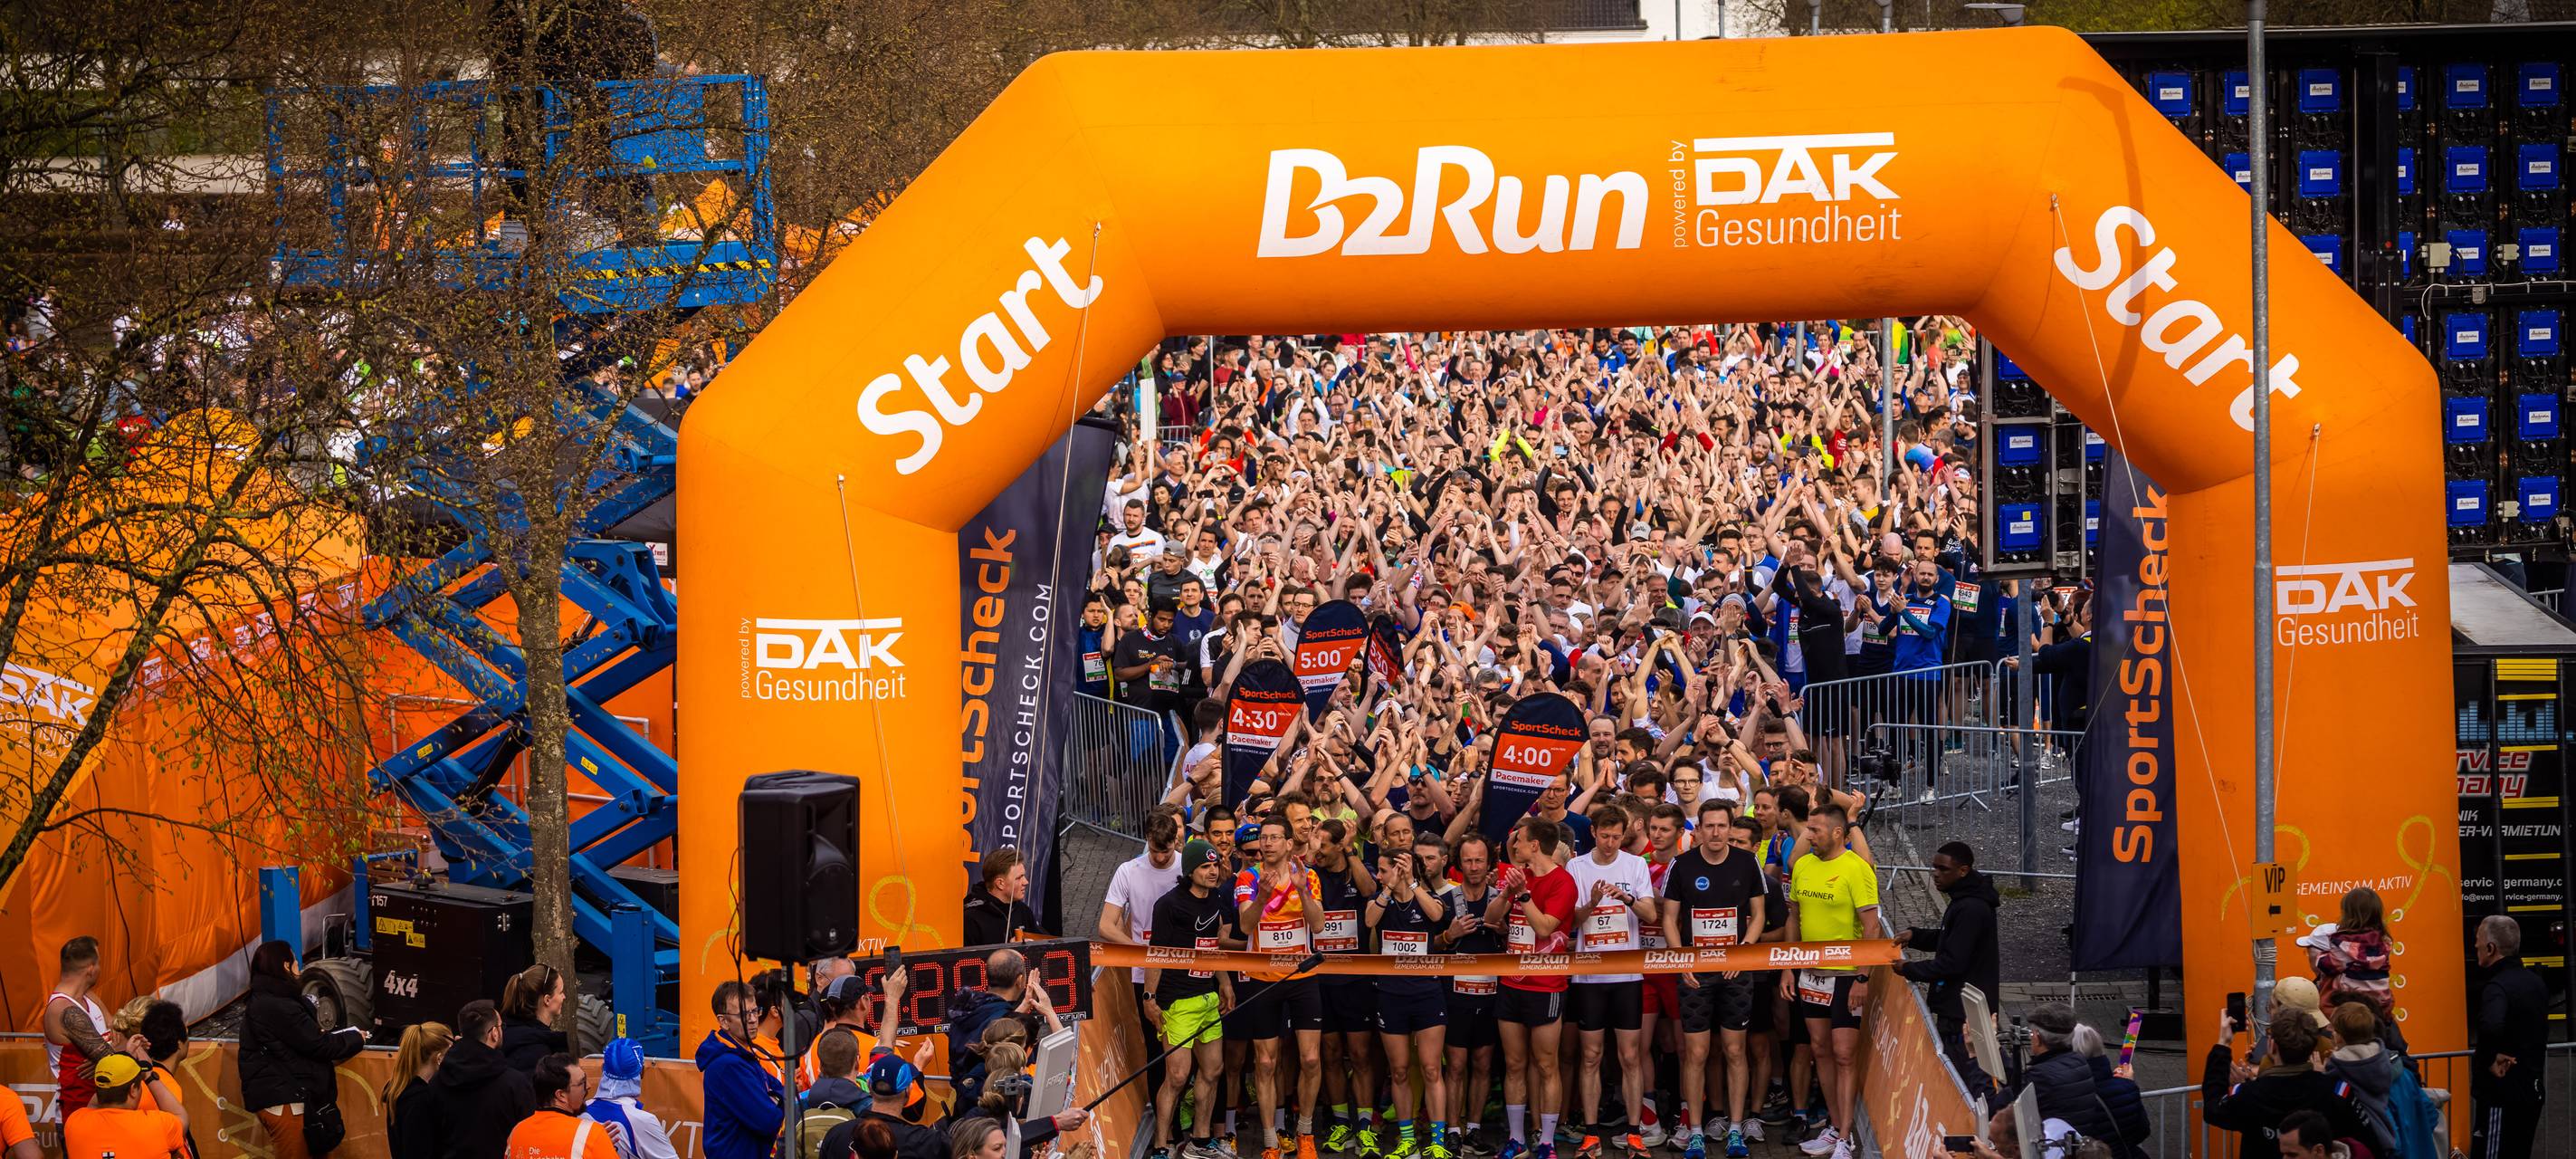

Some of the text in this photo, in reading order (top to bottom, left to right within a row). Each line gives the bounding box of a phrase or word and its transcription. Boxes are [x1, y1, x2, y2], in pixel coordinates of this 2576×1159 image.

[1693, 131, 1901, 206] DAK
[1673, 139, 1688, 248] powered by
[1257, 145, 1649, 259] B2Run
[1695, 204, 1901, 248] Gesundheit
[2054, 206, 2301, 432] Start
[857, 236, 1103, 474] Start
[2276, 558, 2419, 615] DAK
[1305, 627, 1362, 639] SportScheck
[2277, 609, 2419, 647] Gesundheit
[756, 617, 905, 669] DAK
[739, 618, 750, 698] powered by
[1301, 649, 1340, 669] 5:00
[1298, 675, 1337, 685] Pacemaker
[2113, 484, 2168, 862] SportScheck
[756, 669, 906, 702] Gesundheit
[1239, 686, 1296, 700] SportScheck
[1232, 707, 1277, 731] 4:30
[1511, 720, 1581, 737] SportScheck
[1231, 734, 1272, 747] Pacemaker
[1503, 744, 1551, 767] 4:00
[1495, 771, 1546, 786] Pacemaker
[1493, 785, 1539, 794] SPORTSCHECK.COM
[2265, 866, 2285, 894] VIP
[2378, 876, 2413, 891] AKTIV
[1324, 922, 1343, 932] 991
[1598, 916, 1610, 925] 67
[1702, 919, 1728, 929] 1724
[1273, 931, 1293, 941] 810
[858, 937, 888, 952] KTIV
[1392, 942, 1417, 953] 1002
[1700, 948, 1727, 957] DAK
[1825, 945, 1852, 955] DAK
[1520, 953, 1570, 964] B2Run
[1645, 950, 1695, 963] B2Run
[1769, 946, 1820, 962] B2Run
[384, 970, 419, 999] 4x4
[529, 1147, 540, 1155] Die
